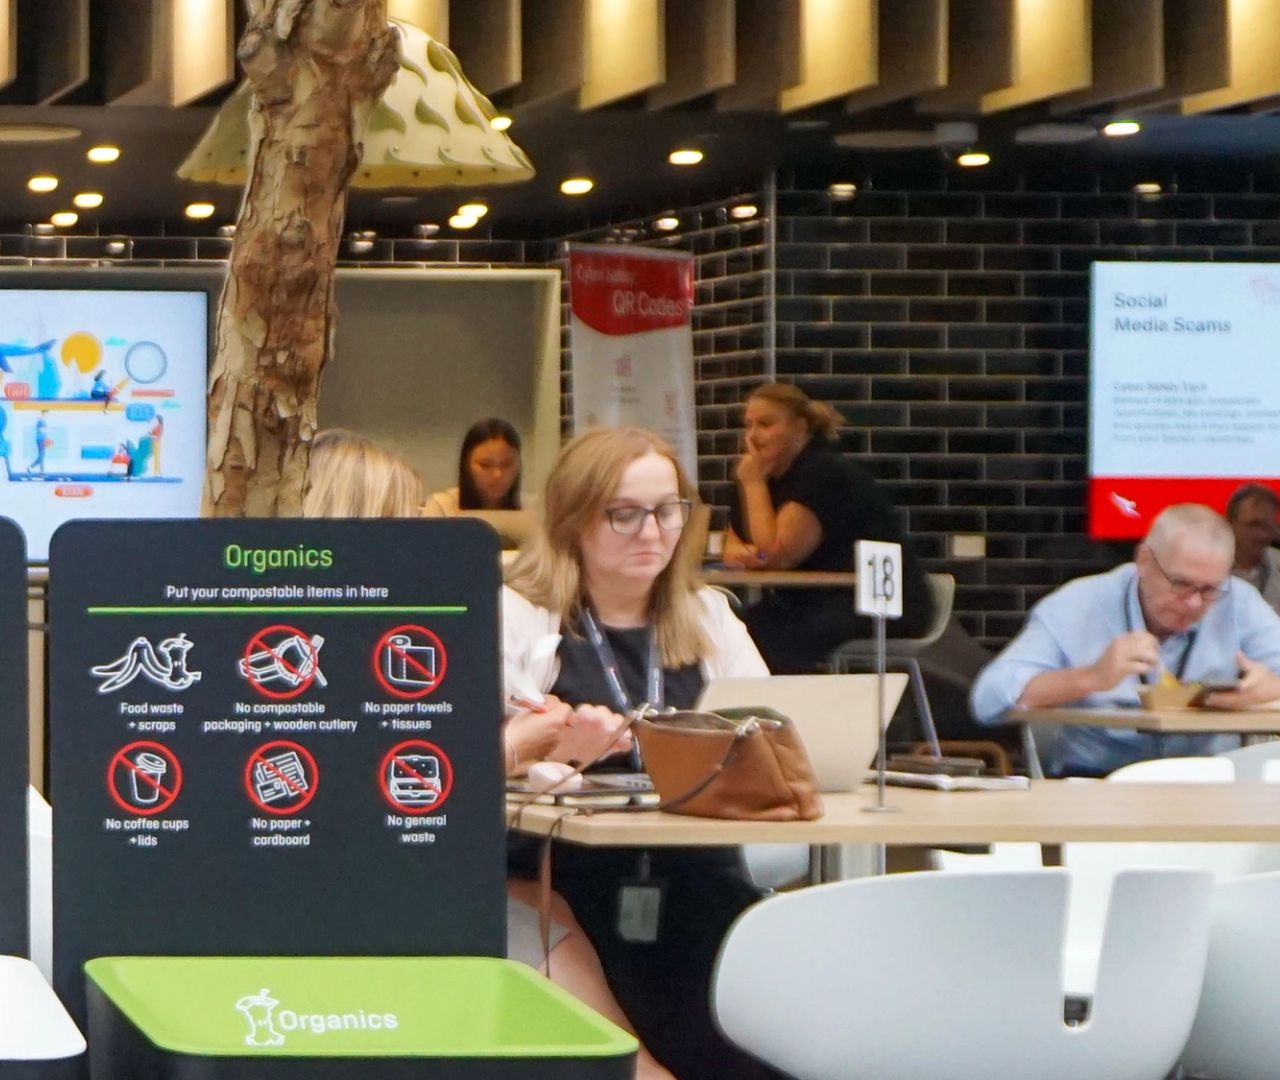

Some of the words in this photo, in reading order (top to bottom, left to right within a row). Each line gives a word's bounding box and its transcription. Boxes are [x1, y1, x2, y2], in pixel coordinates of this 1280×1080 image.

[639, 292, 684, 316] Codes
[1115, 295, 1166, 307] Social
[1115, 317, 1168, 332] Media
[1174, 318, 1231, 332] Scams
[226, 544, 332, 572] Organics
[866, 553, 896, 602] 18
[167, 586, 189, 598] Put
[191, 588, 219, 600] your
[222, 585, 304, 600] compostable
[307, 586, 343, 597] items
[346, 585, 357, 597] in
[361, 585, 388, 597] here
[121, 703, 148, 713] Food
[150, 704, 183, 713] waste
[138, 722, 176, 732] scraps
[252, 818, 267, 829] No
[270, 820, 302, 831] paper
[388, 815, 402, 826] No
[405, 815, 446, 828] general
[254, 834, 310, 845] cardboard
[402, 832, 435, 842] waste
[277, 1010, 398, 1037] Organics
